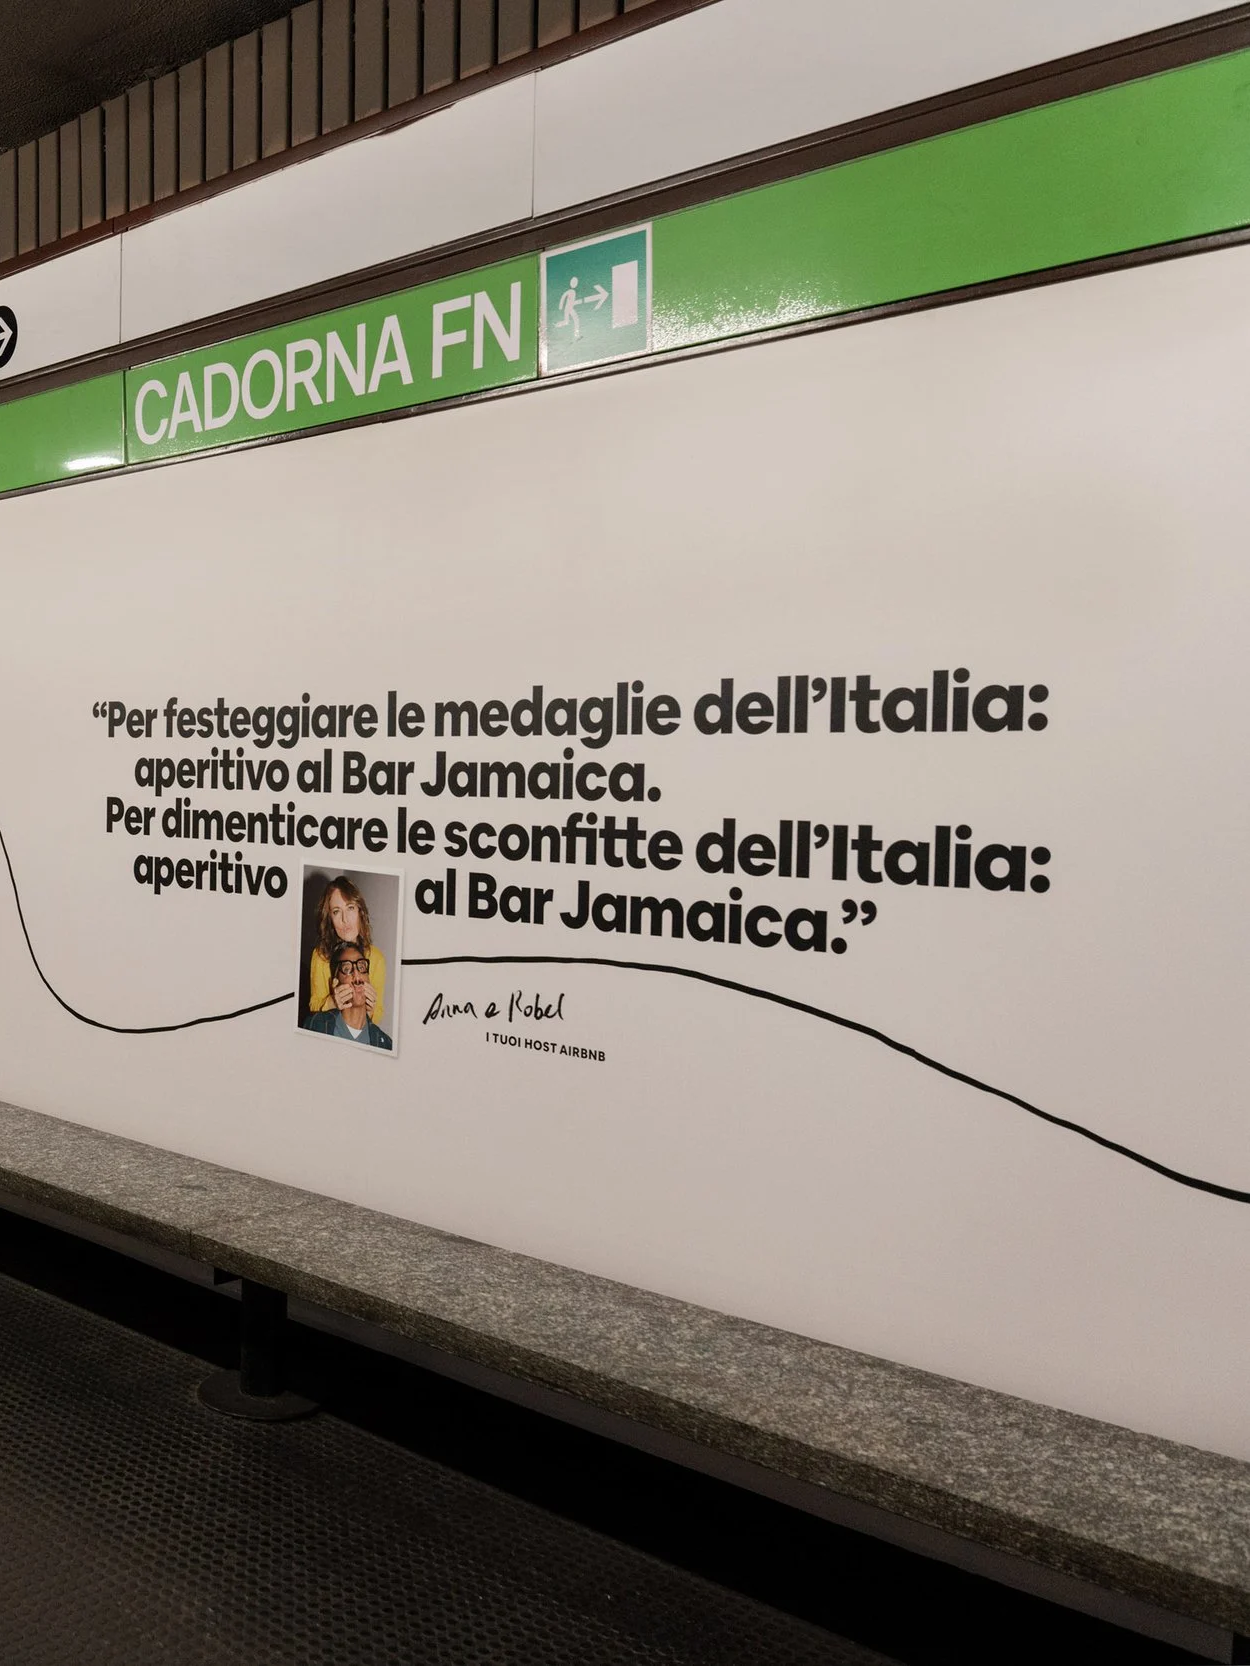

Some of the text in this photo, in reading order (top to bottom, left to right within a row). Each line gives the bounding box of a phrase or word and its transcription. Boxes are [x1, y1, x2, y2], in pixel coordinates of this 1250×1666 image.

[134, 281, 522, 446] CADORNA FN
[92, 667, 1050, 749] “Per festeggiare le medaglie dell’Italia:
[134, 747, 662, 802] aperitivo al Bar Jamaica.
[106, 797, 1052, 894] Per dimenticare le sconfitte dell’Italia:
[133, 848, 878, 955] aperitivo al Bar Jamaica.”
[422, 993, 478, 1025] Anna
[485, 1001, 501, 1019] e
[485, 1032, 606, 1062] I TUOI HOST AIRBNB
